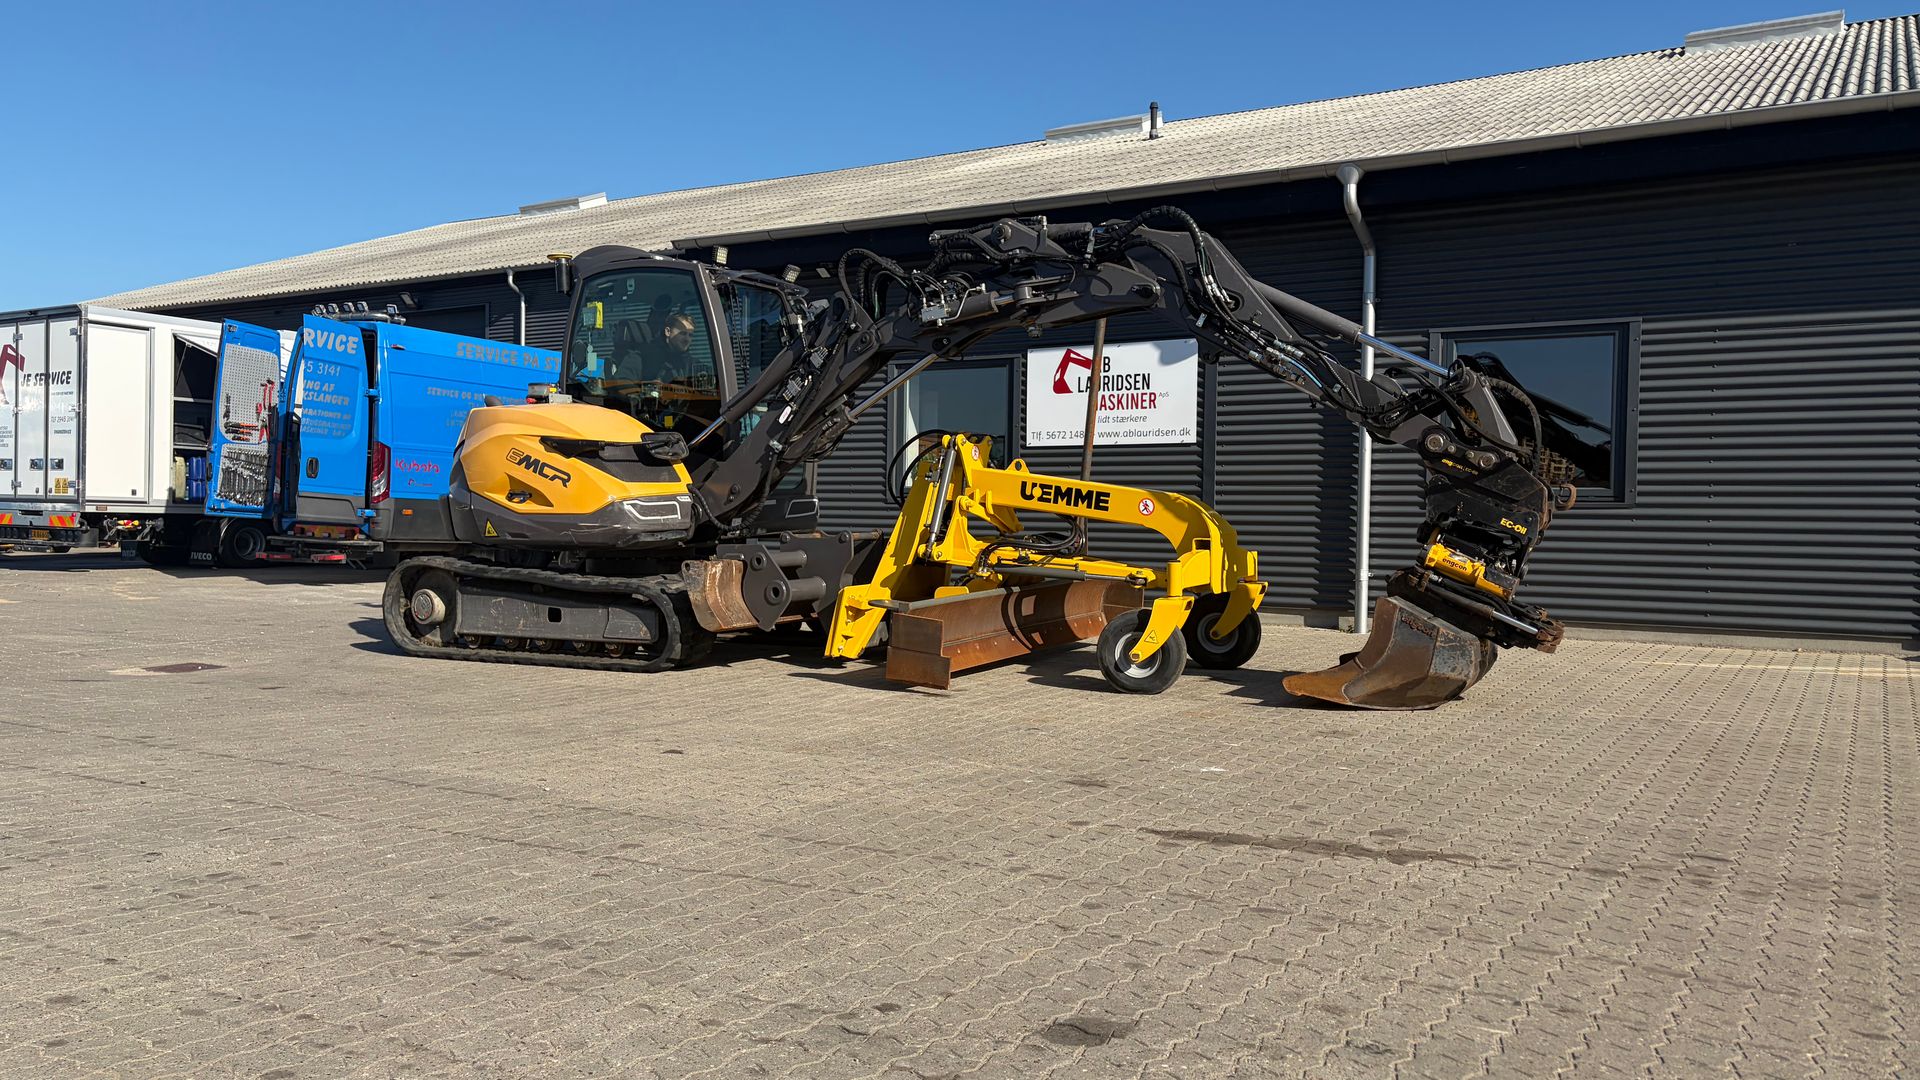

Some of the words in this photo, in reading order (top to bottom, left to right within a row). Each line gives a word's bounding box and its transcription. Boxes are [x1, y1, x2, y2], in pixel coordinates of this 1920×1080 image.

[455, 341, 519, 366] SERVICE
[544, 356, 561, 371] ST
[1100, 356, 1111, 373] B
[303, 360, 313, 373] 5
[317, 362, 341, 377] 3141
[33, 370, 72, 387] SERVICE
[1078, 373, 1151, 393] LARIDSEN
[1096, 392, 1157, 411] ASKINER
[1112, 415, 1148, 424] stærkere
[1031, 431, 1044, 441] Tlf.
[1046, 431, 1067, 440] 5672
[1069, 430, 1085, 439] 148
[1097, 427, 1191, 439] www.ablauridsen.dk
[394, 457, 440, 473] Kubota
[190, 551, 212, 560] IVECO
[1442, 558, 1467, 571] engcon
